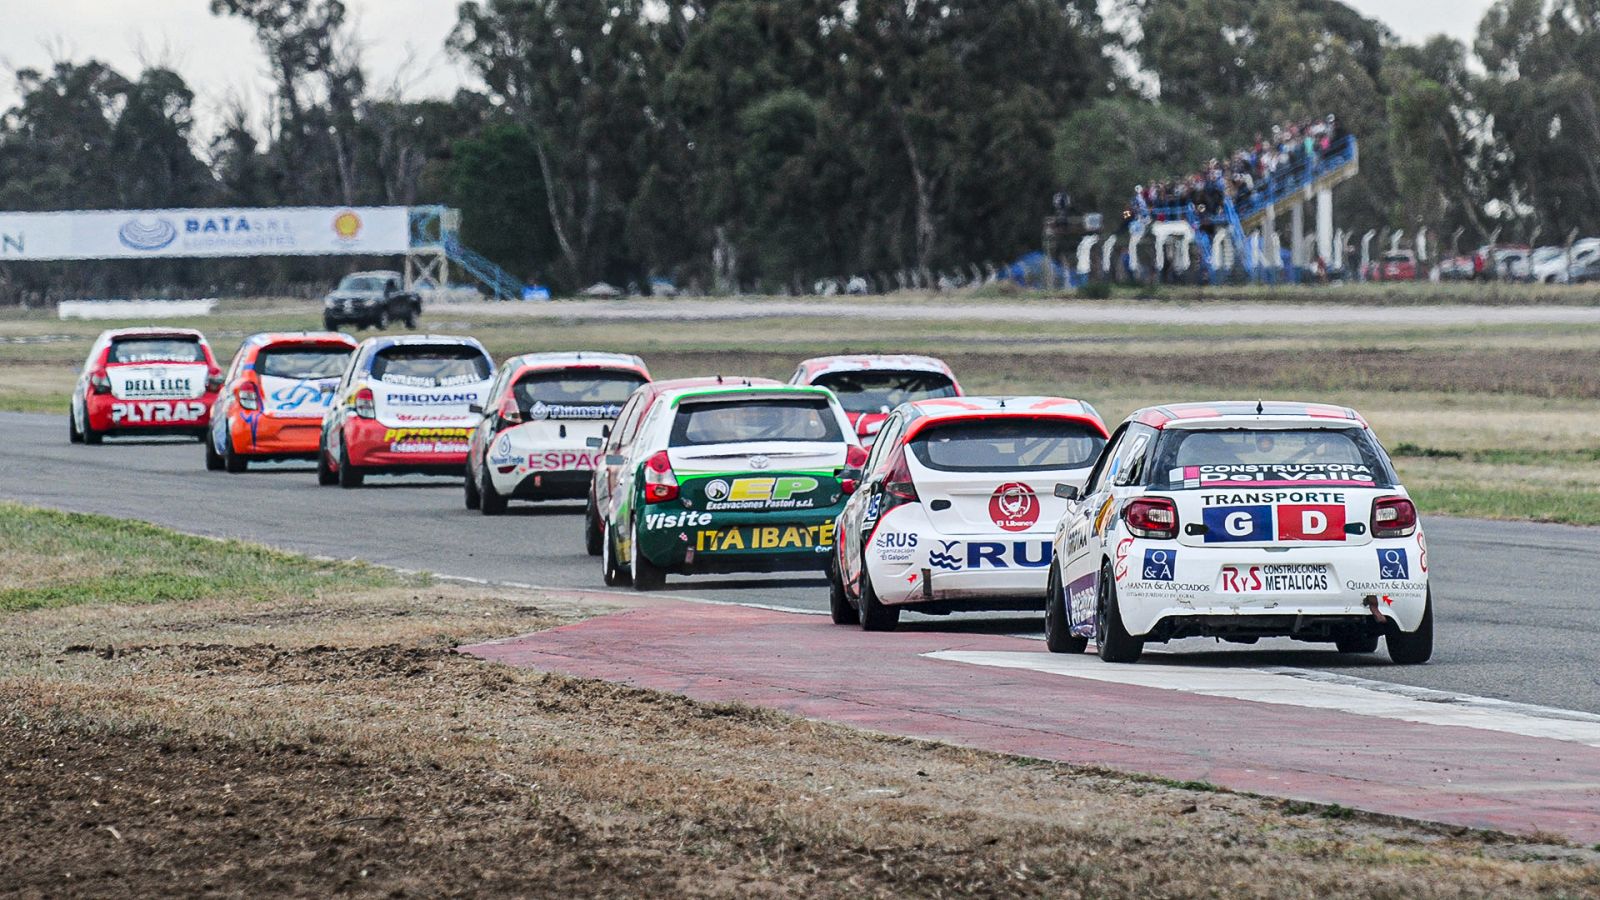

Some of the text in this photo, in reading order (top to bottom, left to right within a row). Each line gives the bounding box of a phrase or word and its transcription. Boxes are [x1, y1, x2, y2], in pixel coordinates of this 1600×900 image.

[185, 216, 250, 233] BATA
[387, 394, 478, 403] PIROVANO
[111, 402, 206, 423] PLYRAP
[1200, 464, 1371, 475] CONSTRUCTORA
[1201, 472, 1373, 482] Del Valle
[729, 476, 819, 502] EP
[706, 500, 763, 511] Excavaciones
[765, 499, 795, 509] Pastori
[1201, 492, 1345, 506] TRANSPORTE
[1224, 511, 1328, 536] G D
[751, 519, 834, 549] IBATÉ
[886, 533, 918, 548] RUS
[1151, 550, 1167, 565] Q
[1385, 550, 1400, 564] Q
[1144, 565, 1172, 579] & A
[1263, 565, 1327, 575] CONSTRUCCIONES
[1381, 564, 1407, 578] & A
[1265, 575, 1328, 591] METALICAS
[1346, 580, 1390, 591] QUARANTA
